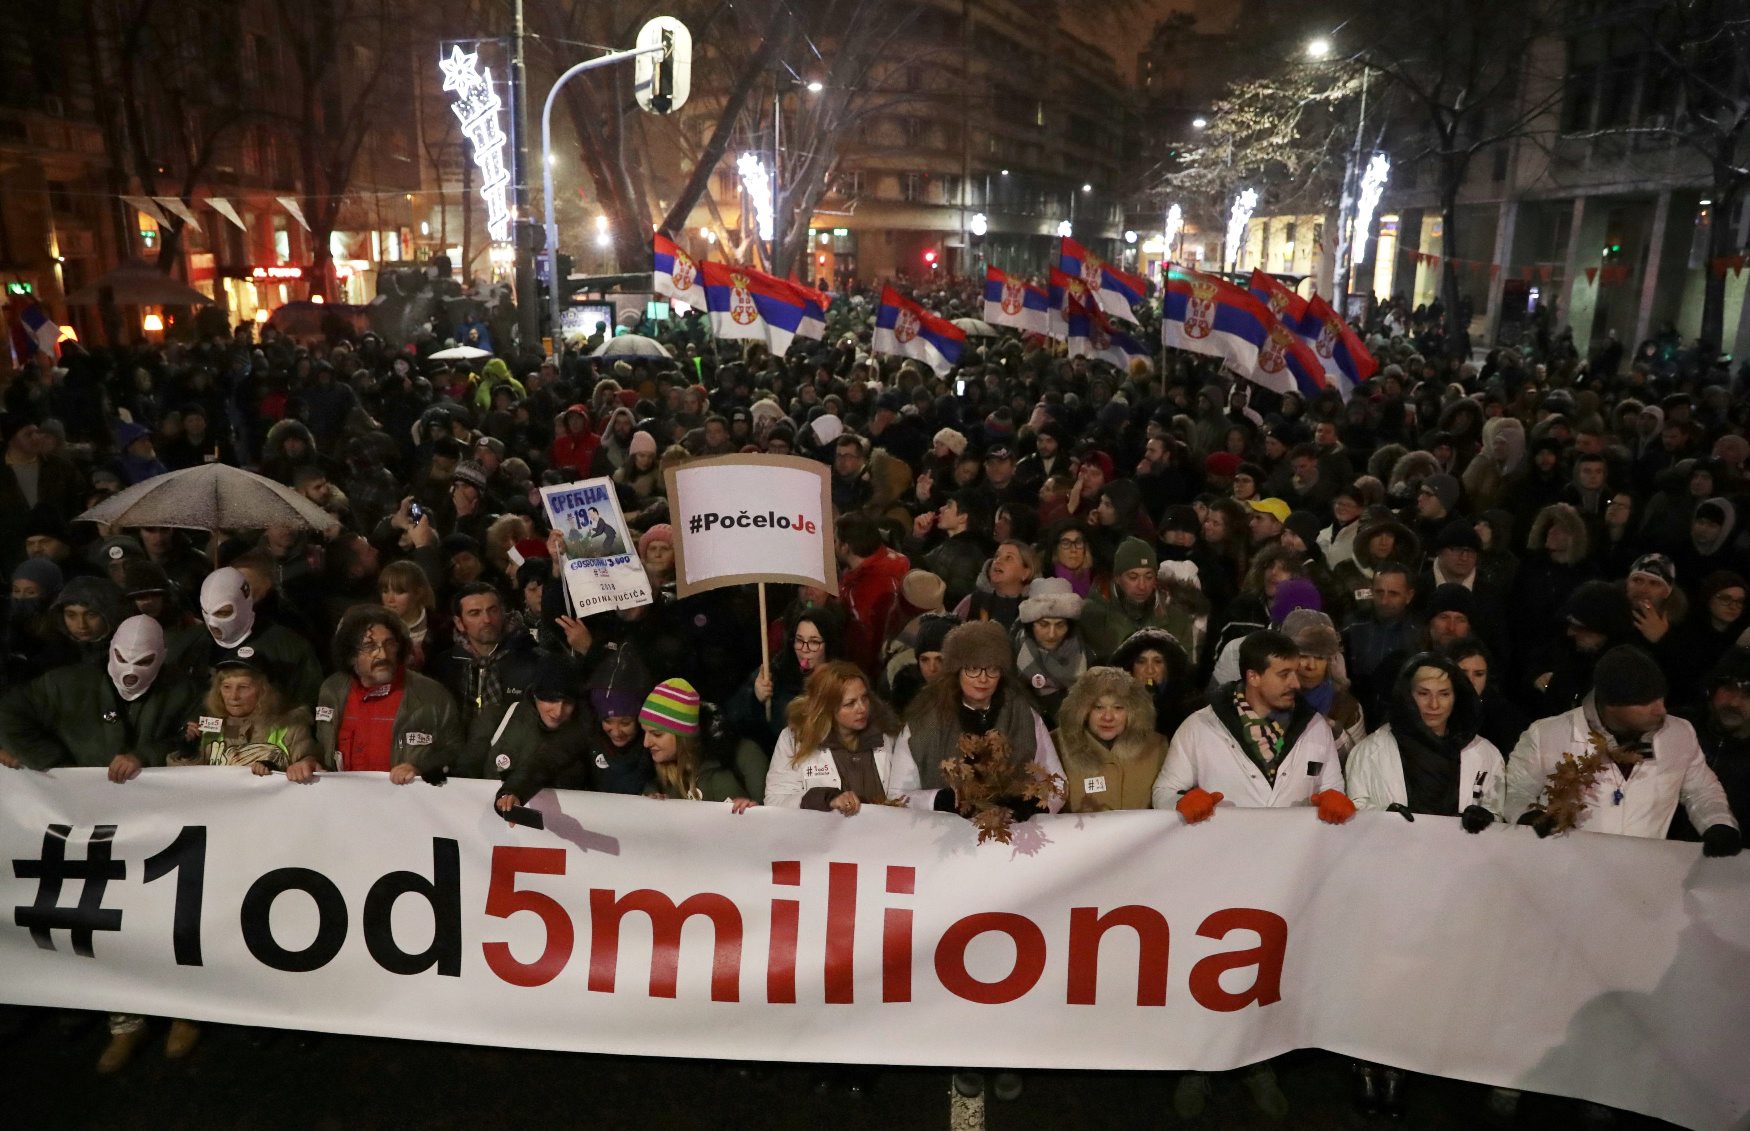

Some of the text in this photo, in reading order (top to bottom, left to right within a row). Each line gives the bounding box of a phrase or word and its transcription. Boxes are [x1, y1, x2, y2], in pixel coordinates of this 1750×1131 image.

[689, 510, 816, 534] #PočeloJe
[579, 595, 612, 608] GODINA
[12, 824, 1289, 1012] #1od5miliona
